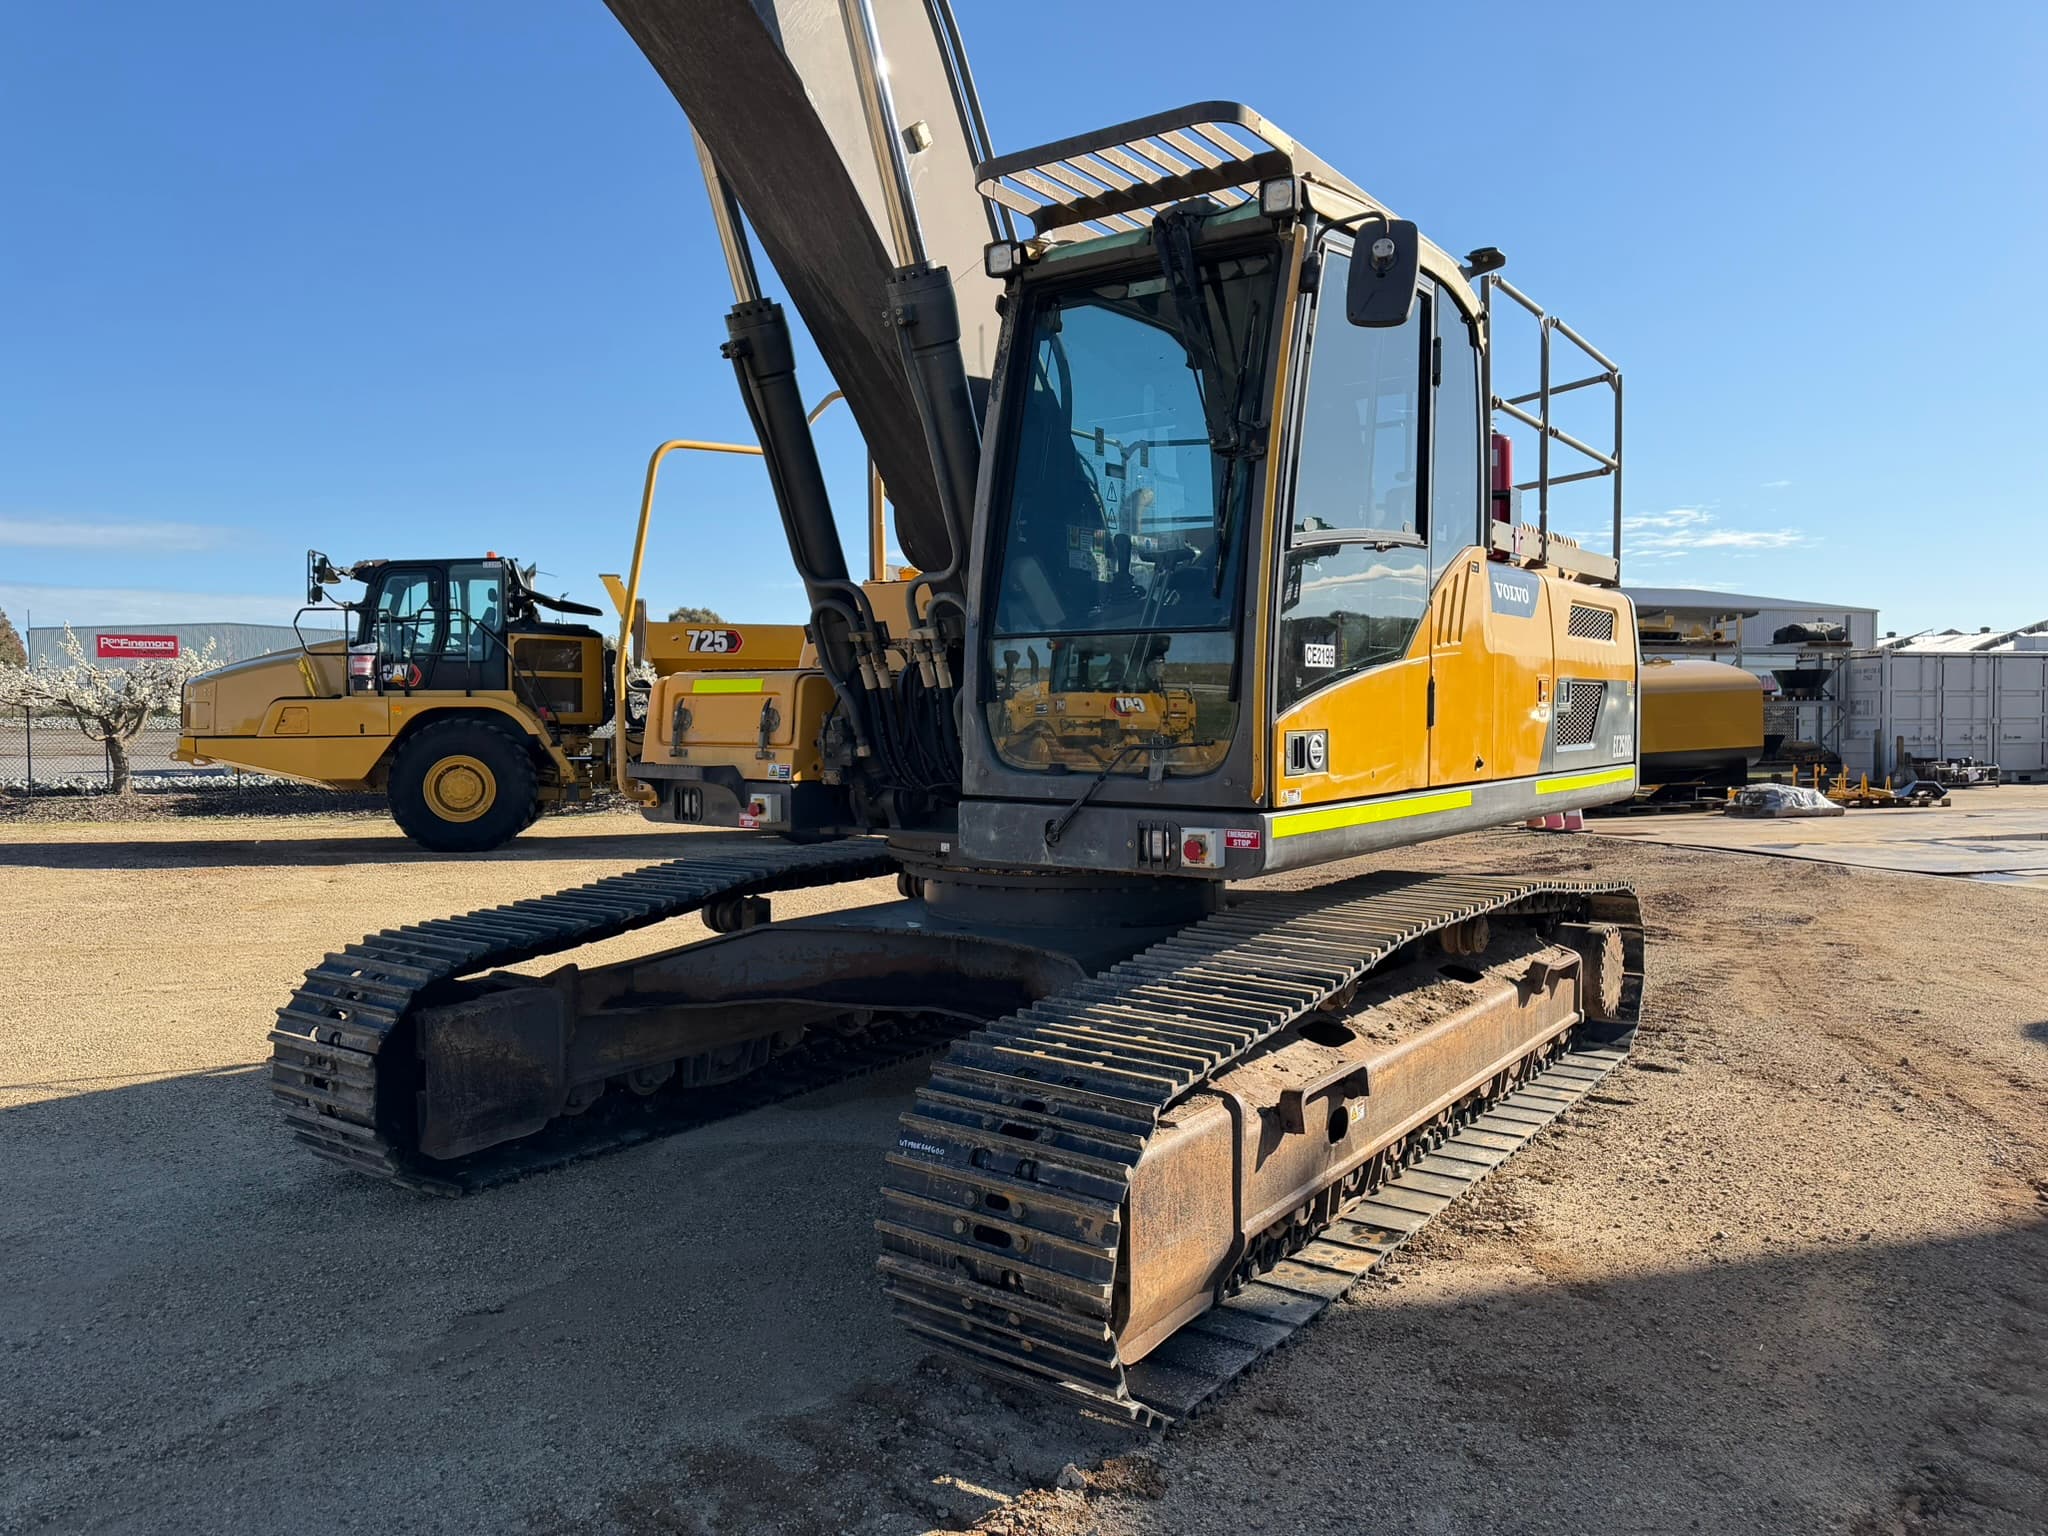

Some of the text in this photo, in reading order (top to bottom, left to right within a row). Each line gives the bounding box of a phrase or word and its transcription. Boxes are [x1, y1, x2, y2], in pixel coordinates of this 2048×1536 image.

[1494, 582, 1529, 604] VOLVO
[686, 630, 728, 652] 725
[1307, 645, 1334, 665] CE2199
[382, 663, 409, 682] CAT
[1227, 830, 1258, 839] EMERGENCY
[1233, 839, 1252, 847] STOP
